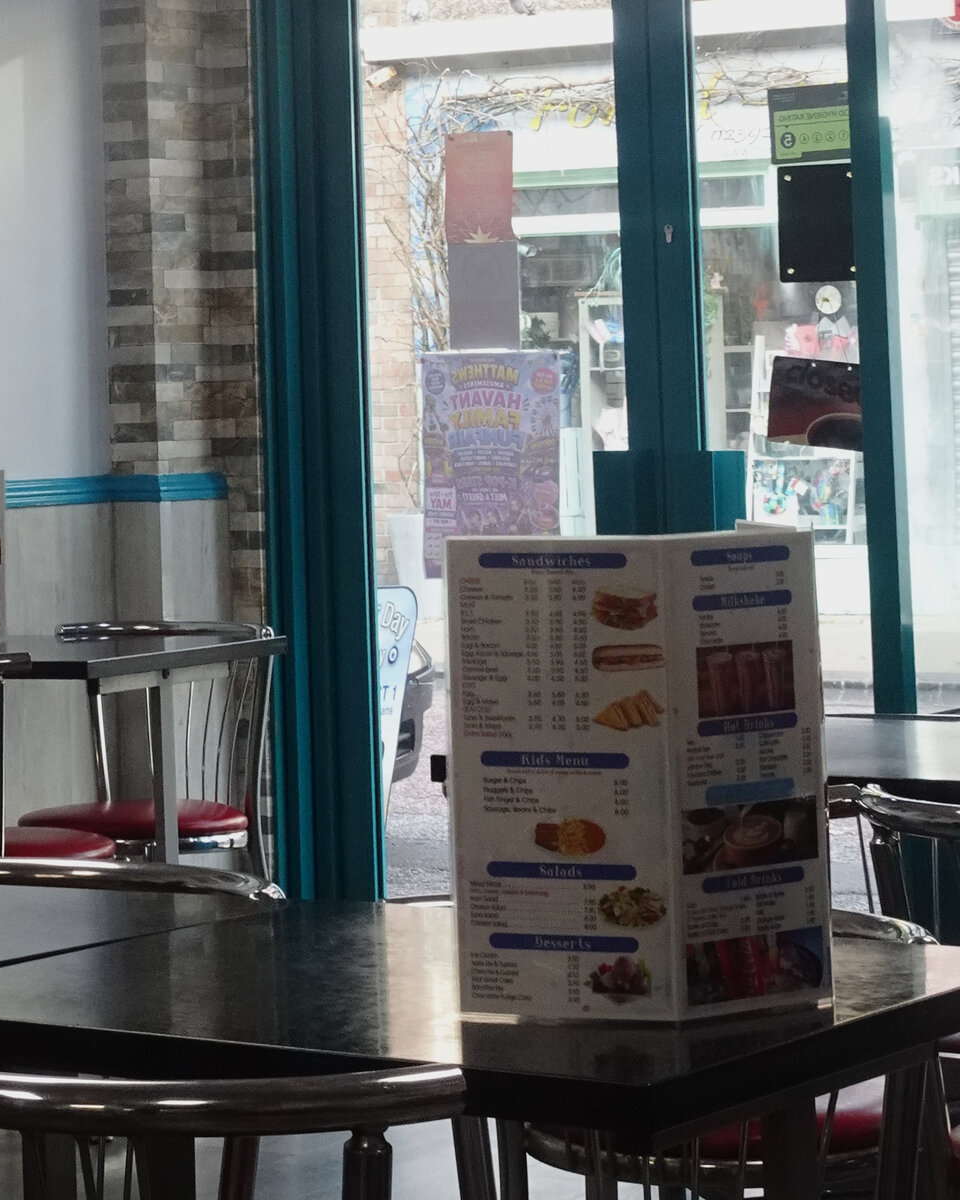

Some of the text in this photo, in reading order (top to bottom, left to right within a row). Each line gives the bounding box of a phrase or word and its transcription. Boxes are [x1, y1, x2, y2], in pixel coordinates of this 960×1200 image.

[511, 554, 591, 568] Sandwiches
[726, 551, 752, 565] Soups
[721, 595, 765, 608] Milkshake
[380, 601, 410, 641] Day
[724, 718, 774, 732] Hot Drinks
[520, 754, 589, 767] Kids Menu
[516, 787, 533, 795] Chips
[539, 865, 583, 878] Salads
[726, 870, 781, 888] Cold Drinks
[534, 935, 592, 950] Desserts
